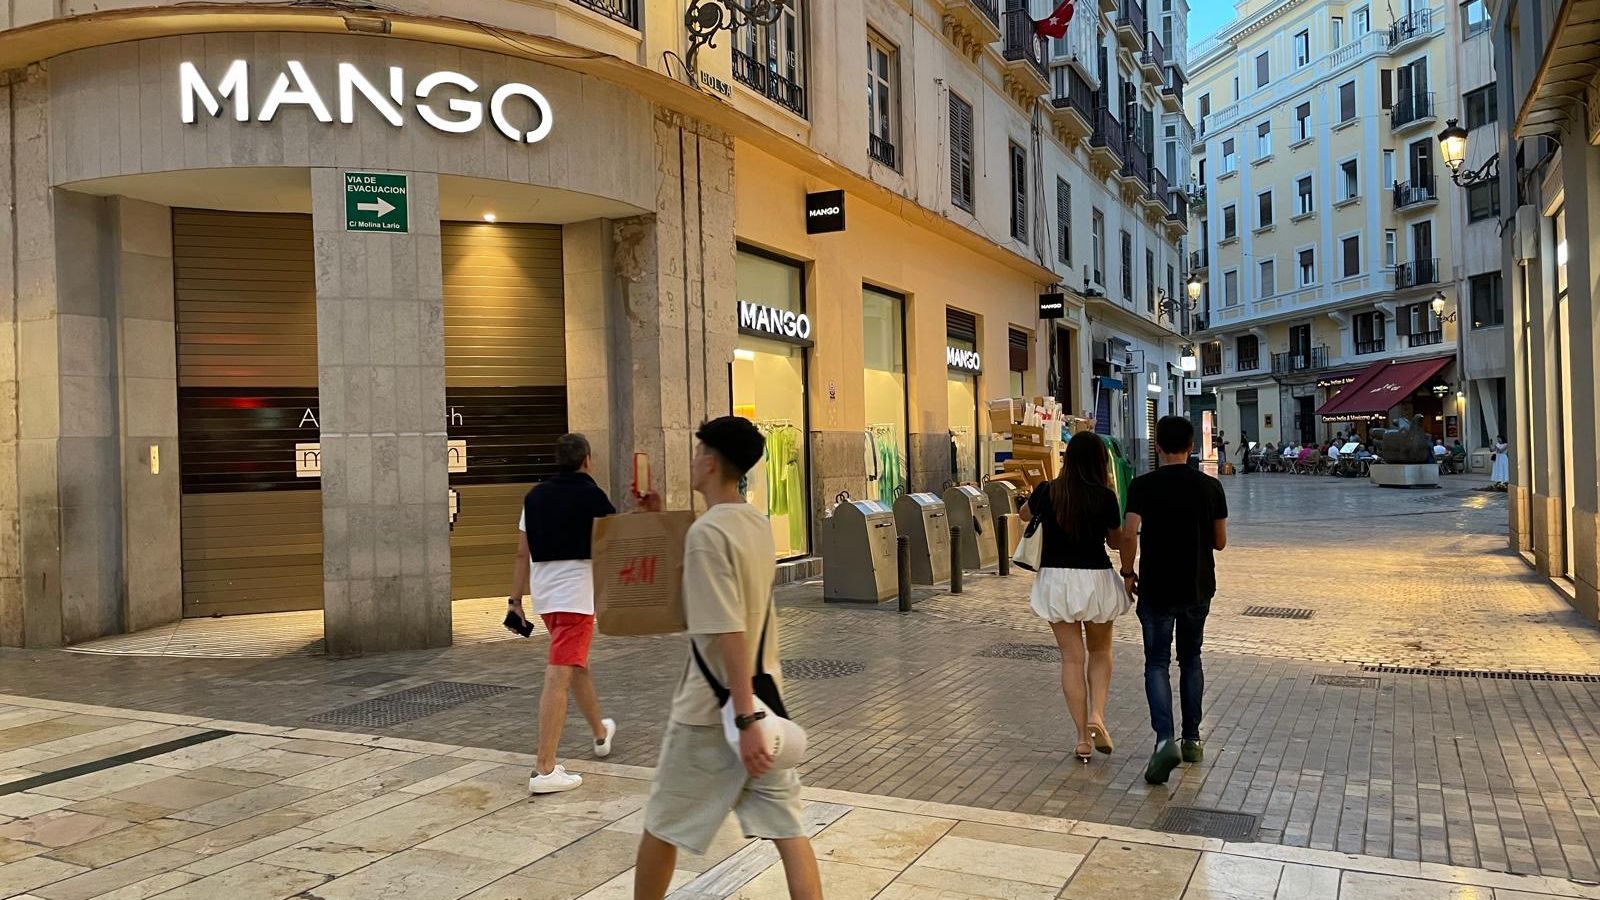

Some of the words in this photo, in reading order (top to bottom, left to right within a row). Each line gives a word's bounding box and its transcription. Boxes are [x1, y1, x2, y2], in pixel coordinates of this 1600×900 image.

[179, 59, 554, 145] MANGO
[347, 185, 405, 194] EVACUACION
[809, 206, 840, 217] MANGO
[740, 300, 811, 339] MANGO
[946, 346, 980, 370] MANGO
